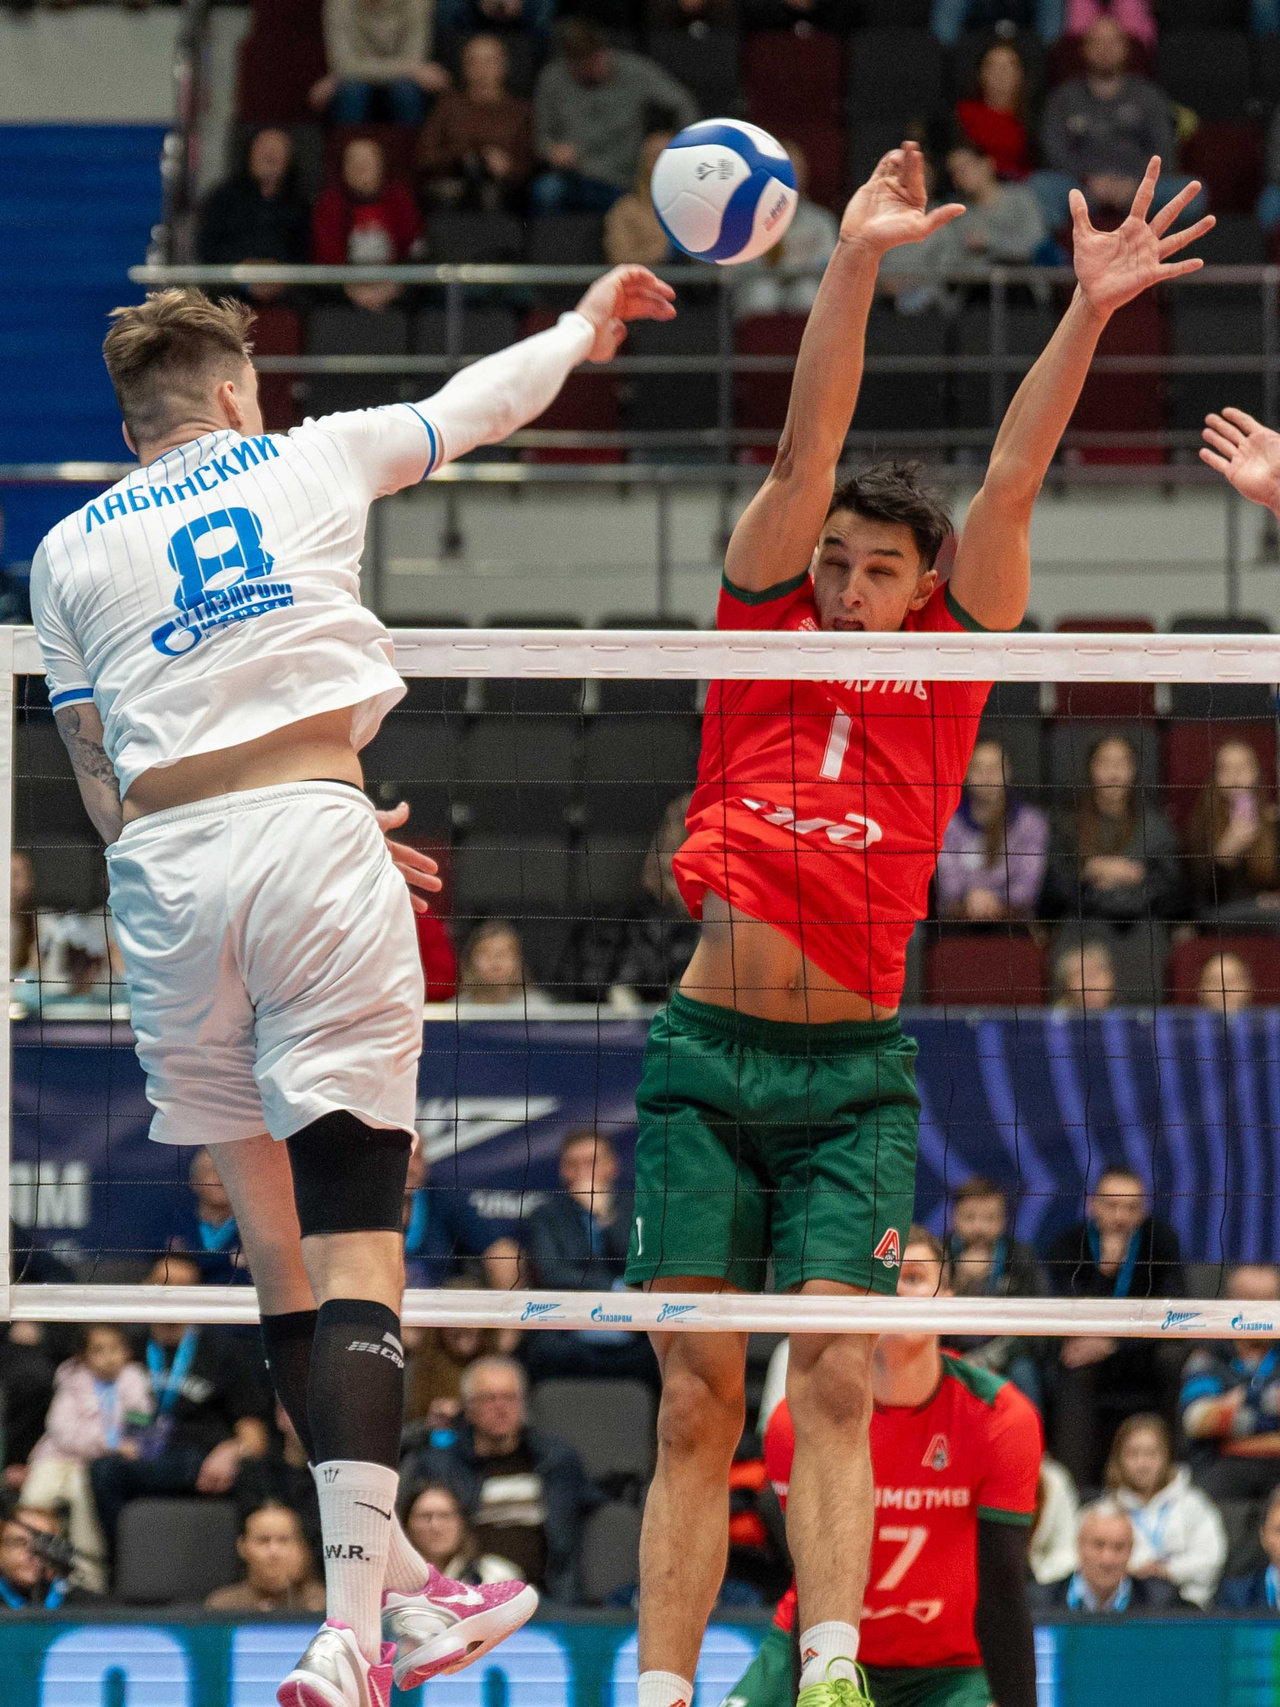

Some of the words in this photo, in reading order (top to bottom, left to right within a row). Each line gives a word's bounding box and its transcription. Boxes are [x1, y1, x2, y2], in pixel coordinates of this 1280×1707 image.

[167, 507, 275, 612] 8
[819, 698, 853, 781] 1
[874, 1525, 929, 1591] 7
